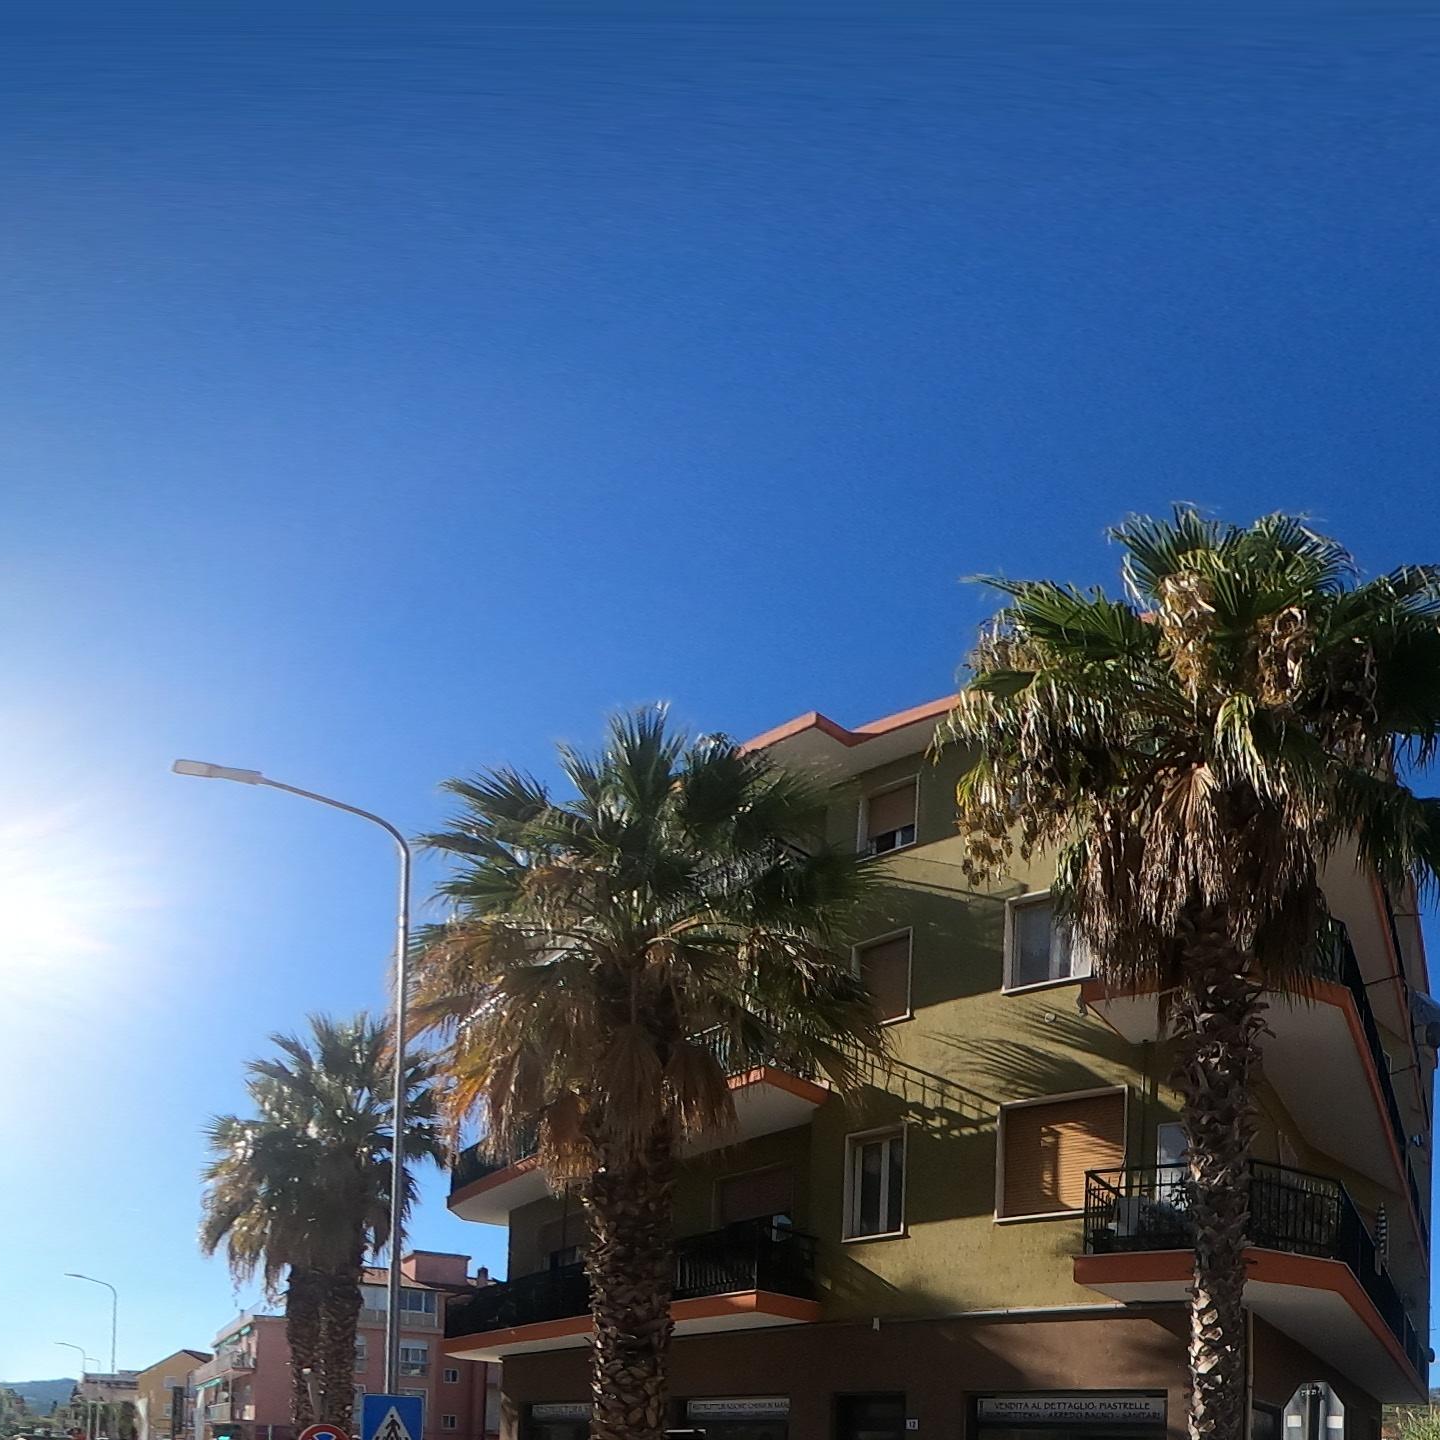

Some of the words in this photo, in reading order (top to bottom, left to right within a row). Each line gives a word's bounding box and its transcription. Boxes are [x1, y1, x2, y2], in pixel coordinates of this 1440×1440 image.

[993, 1401, 1029, 1409] VENDITA
[1031, 1401, 1042, 1409] AL
[1099, 1401, 1151, 1410] PIASTRELLE
